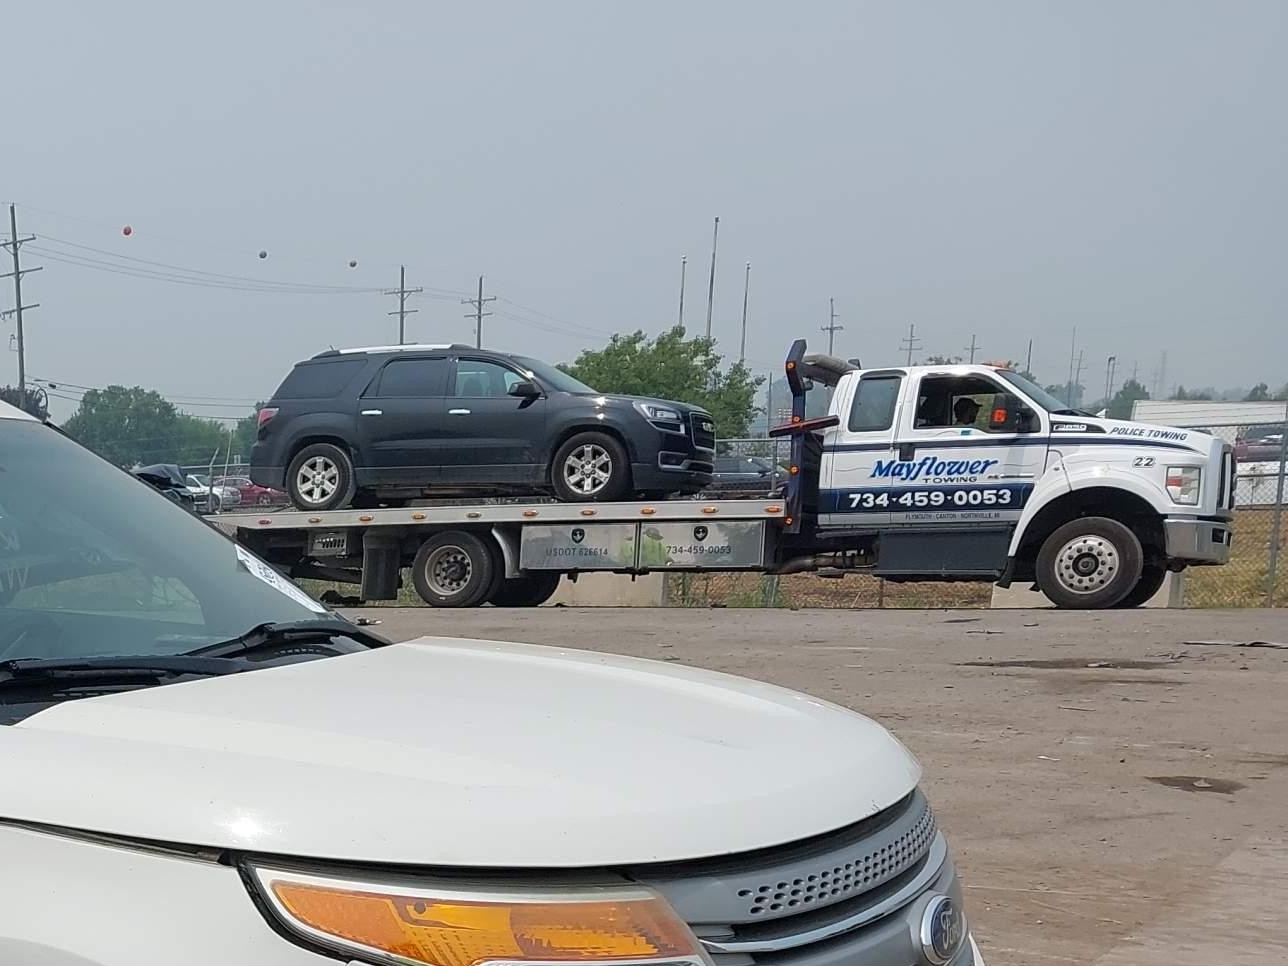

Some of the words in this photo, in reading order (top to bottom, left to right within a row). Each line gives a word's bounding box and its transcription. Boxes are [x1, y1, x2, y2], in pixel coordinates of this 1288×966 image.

[1110, 426, 1145, 437] POLICE
[1147, 429, 1189, 441] TOWING
[1134, 457, 1154, 467] 22
[870, 456, 999, 481] Mayflower
[922, 475, 978, 484] TOWING
[545, 547, 576, 557] USDOT
[665, 545, 732, 555] 734-459-0053
